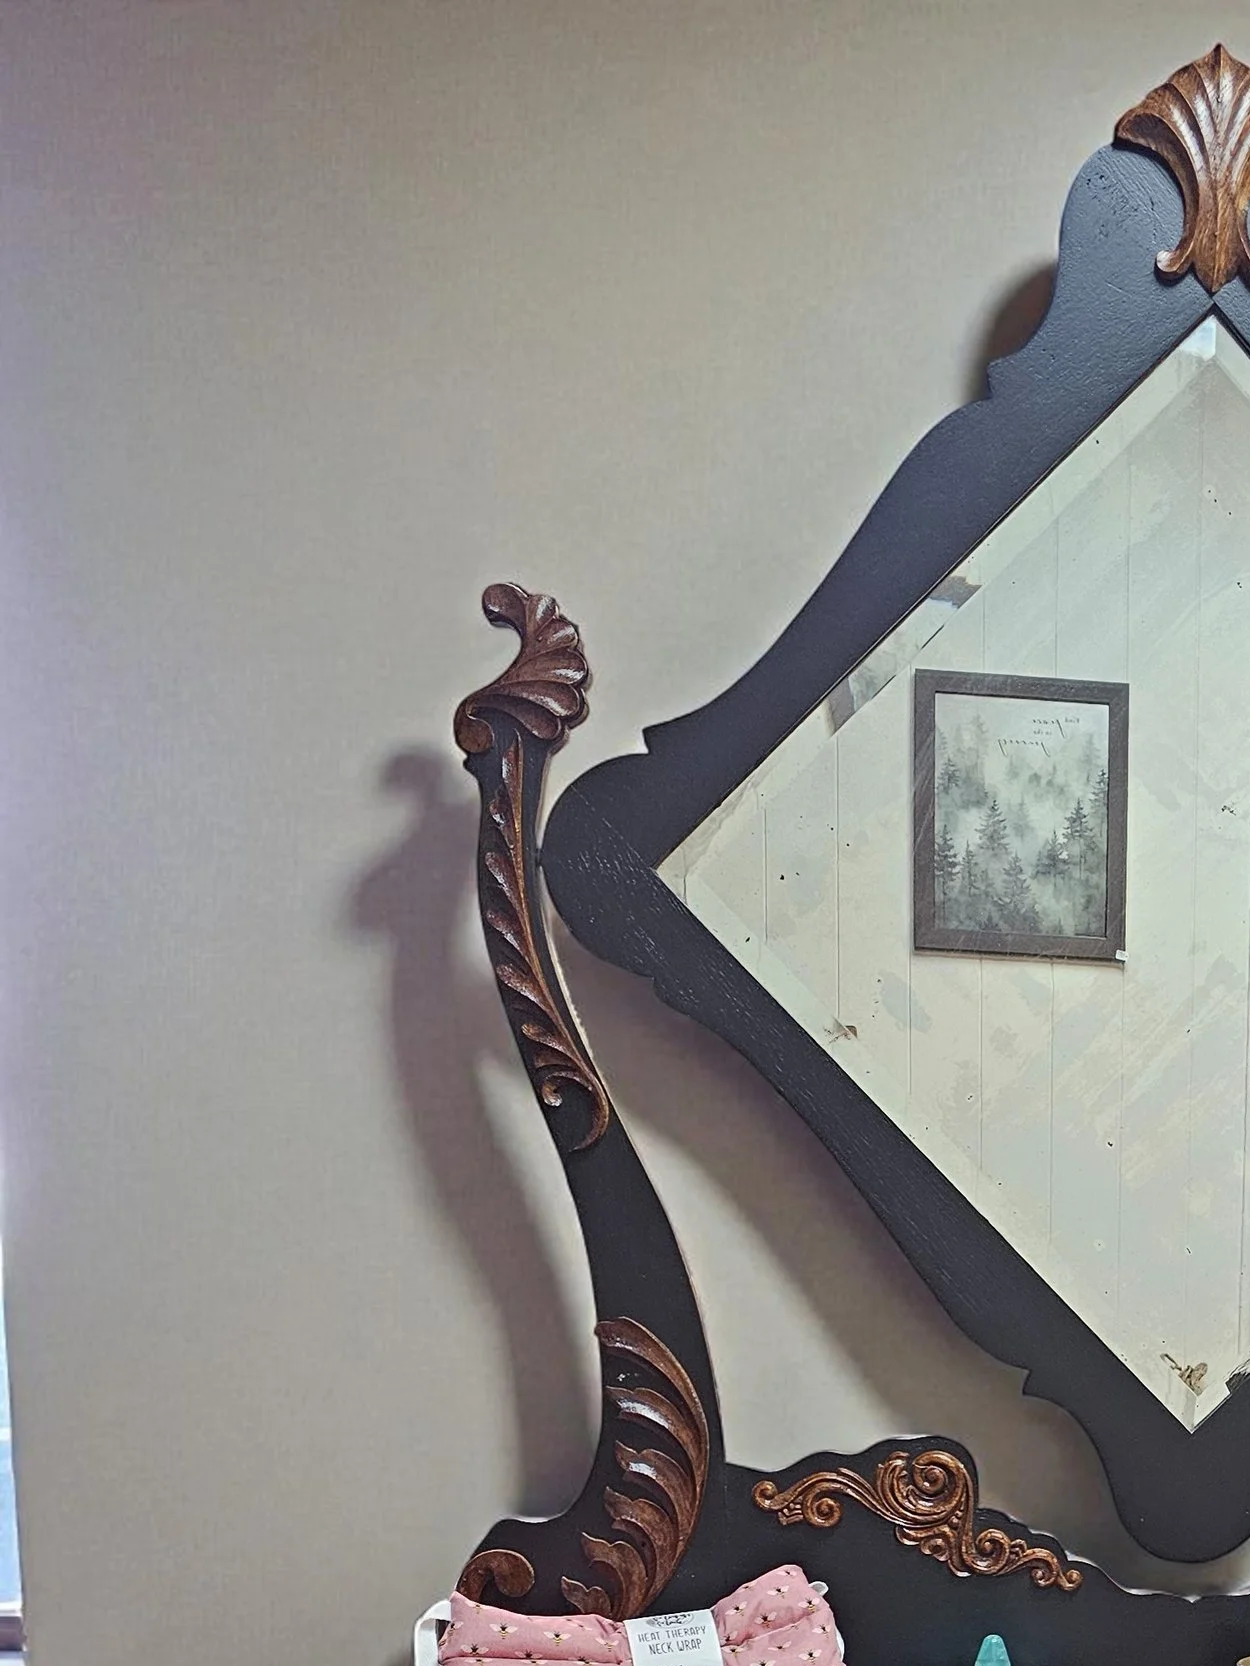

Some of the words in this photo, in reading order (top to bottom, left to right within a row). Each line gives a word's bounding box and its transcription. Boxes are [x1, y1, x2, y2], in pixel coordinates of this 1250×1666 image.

[637, 1631, 661, 1643] HEAT
[666, 1626, 706, 1639] THERAPY
[648, 1641, 674, 1655] NECK
[676, 1638, 702, 1652] WRAP
